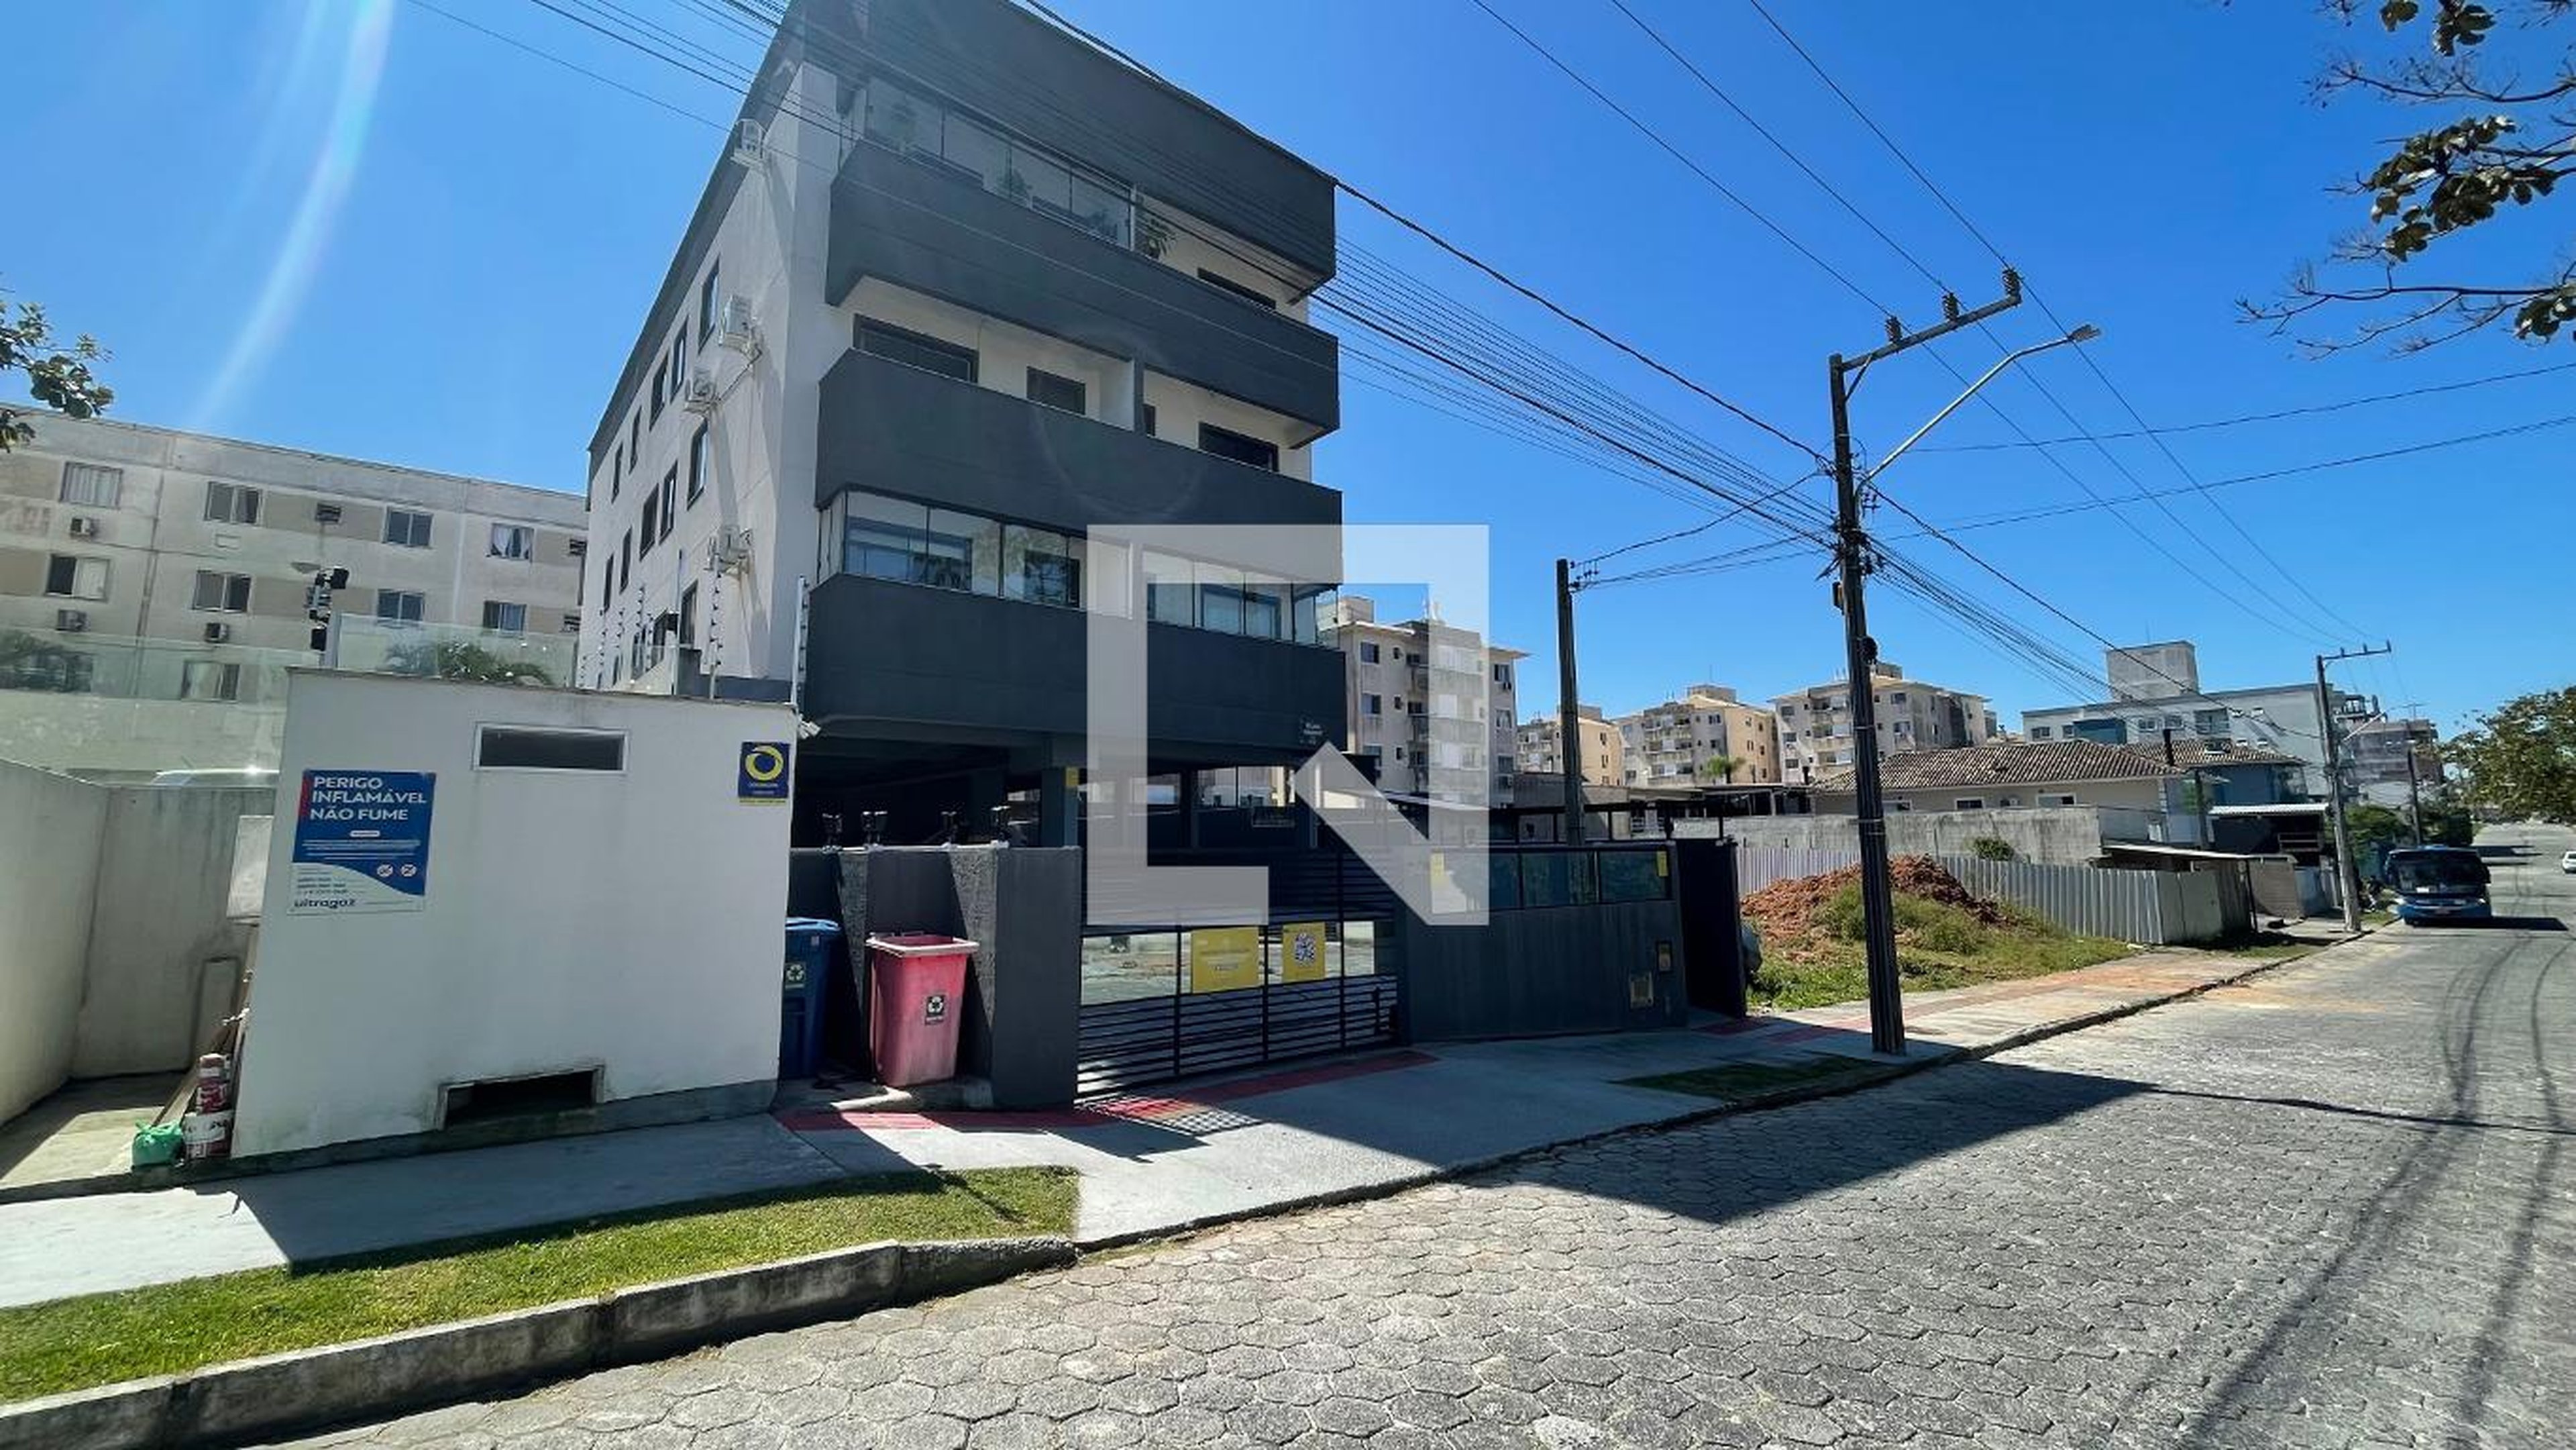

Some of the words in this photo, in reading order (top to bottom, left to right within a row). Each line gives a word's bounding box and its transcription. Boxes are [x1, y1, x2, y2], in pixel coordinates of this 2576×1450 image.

[313, 776, 383, 789] PERIGO
[312, 788, 427, 804] INFLAMÁVEL
[310, 806, 354, 820] NÃO
[358, 809, 409, 820] FUME
